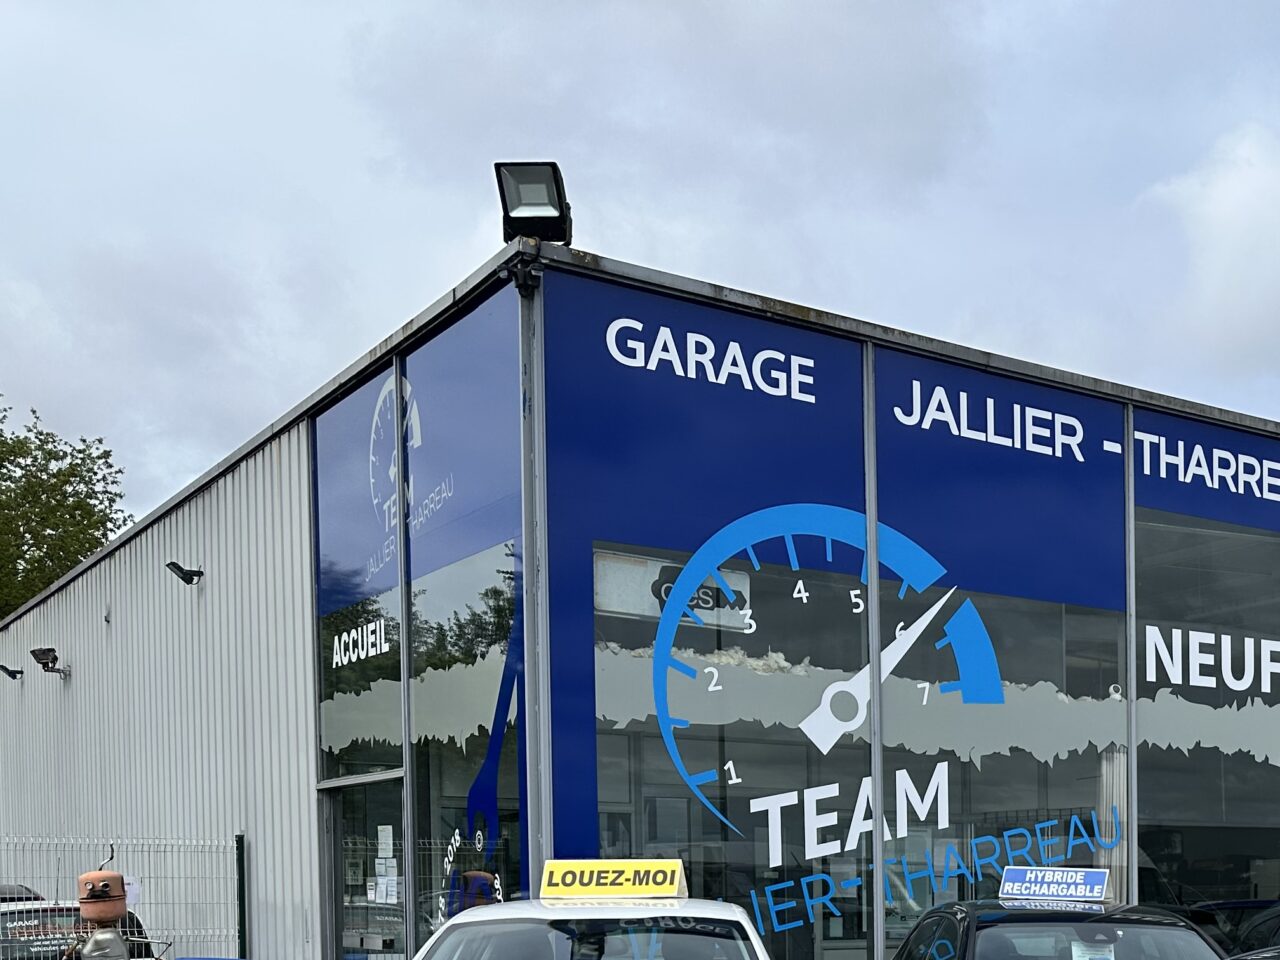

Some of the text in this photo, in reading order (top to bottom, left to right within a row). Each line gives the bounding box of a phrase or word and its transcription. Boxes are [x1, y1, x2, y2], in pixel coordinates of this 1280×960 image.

[605, 317, 816, 404] GARAGE
[893, 379, 1085, 462] JALLIER
[1103, 439, 1122, 454] -
[383, 474, 414, 532] TEM
[365, 473, 454, 582] JALLIER THARREAU
[792, 580, 809, 604] 4
[850, 589, 864, 613] 5
[739, 609, 757, 634] 3
[332, 618, 390, 669] ACCUEIL
[703, 668, 722, 691] 2
[917, 682, 931, 706] 7
[724, 760, 742, 784] 1
[750, 761, 949, 867] TEAM
[547, 869, 676, 888] LOUEZ-MOI
[1025, 870, 1086, 883] HYBRIDE
[1003, 882, 1103, 897] RECHARGABLE
